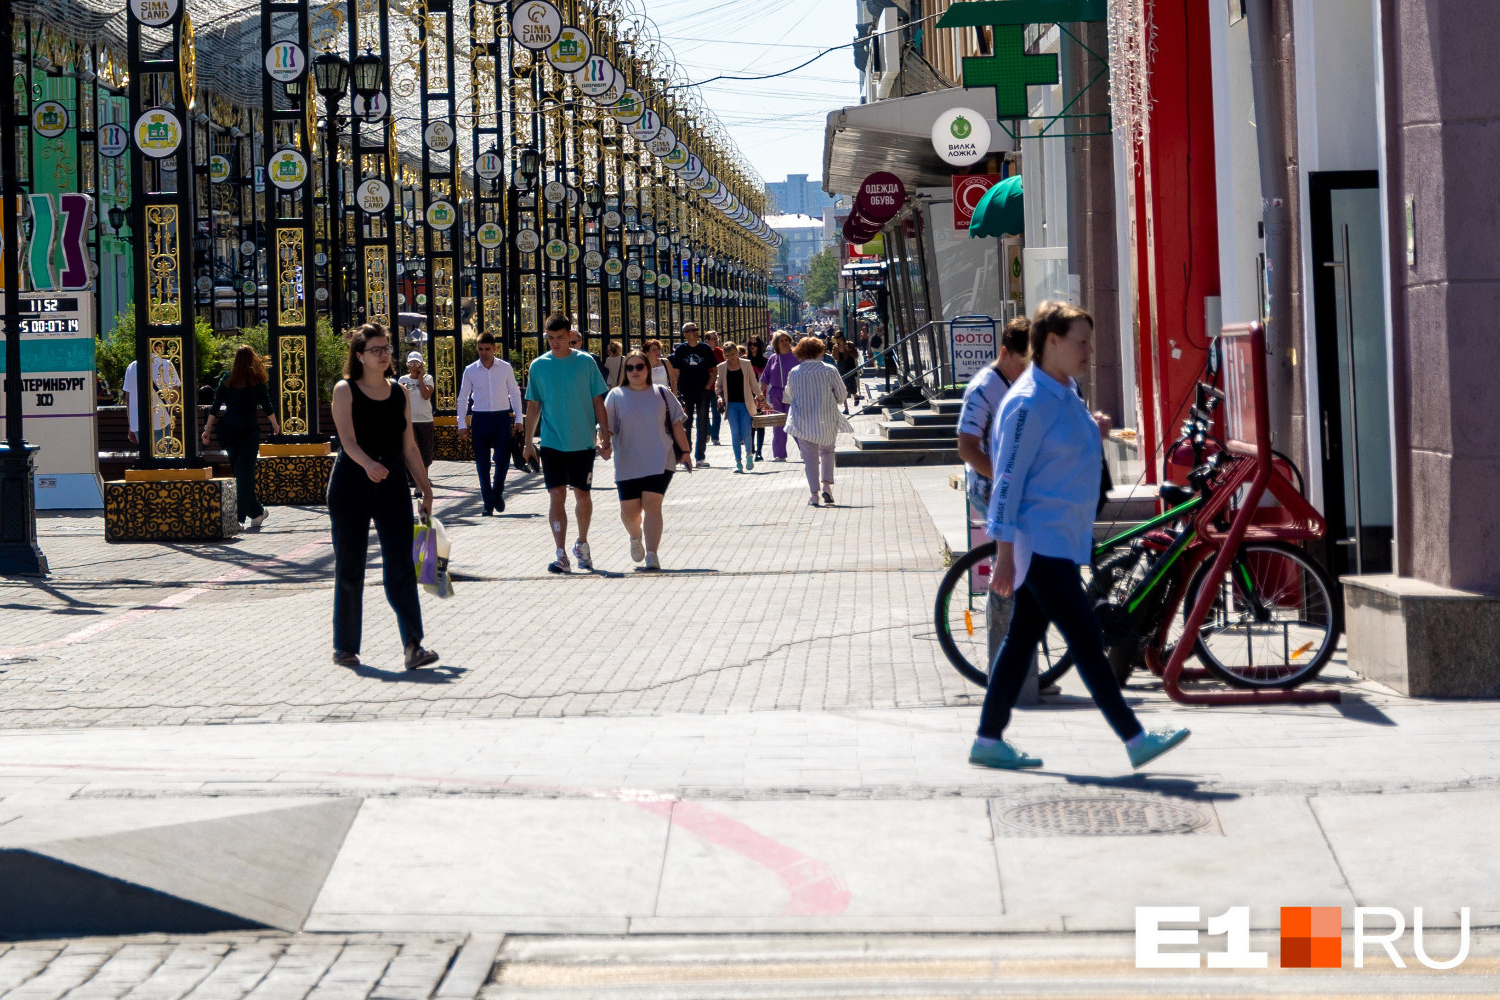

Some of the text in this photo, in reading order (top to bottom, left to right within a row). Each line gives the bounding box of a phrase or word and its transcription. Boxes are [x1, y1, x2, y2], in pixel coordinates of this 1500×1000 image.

[140, 2, 169, 11] SIMA
[140, 10, 171, 21] LAND
[522, 24, 552, 35] SIMA
[522, 33, 553, 44] LAND
[947, 143, 977, 151] ВИЛКА
[947, 149, 978, 158] ЛОЖКА
[865, 183, 900, 195] ОДЕЖДА
[363, 195, 384, 203] SIMA
[870, 195, 895, 206] ОБУВЬ
[954, 333, 993, 343] ФОТО
[955, 350, 994, 359] КОПИ
[4, 377, 86, 393] АТЕРИНБУРГ
